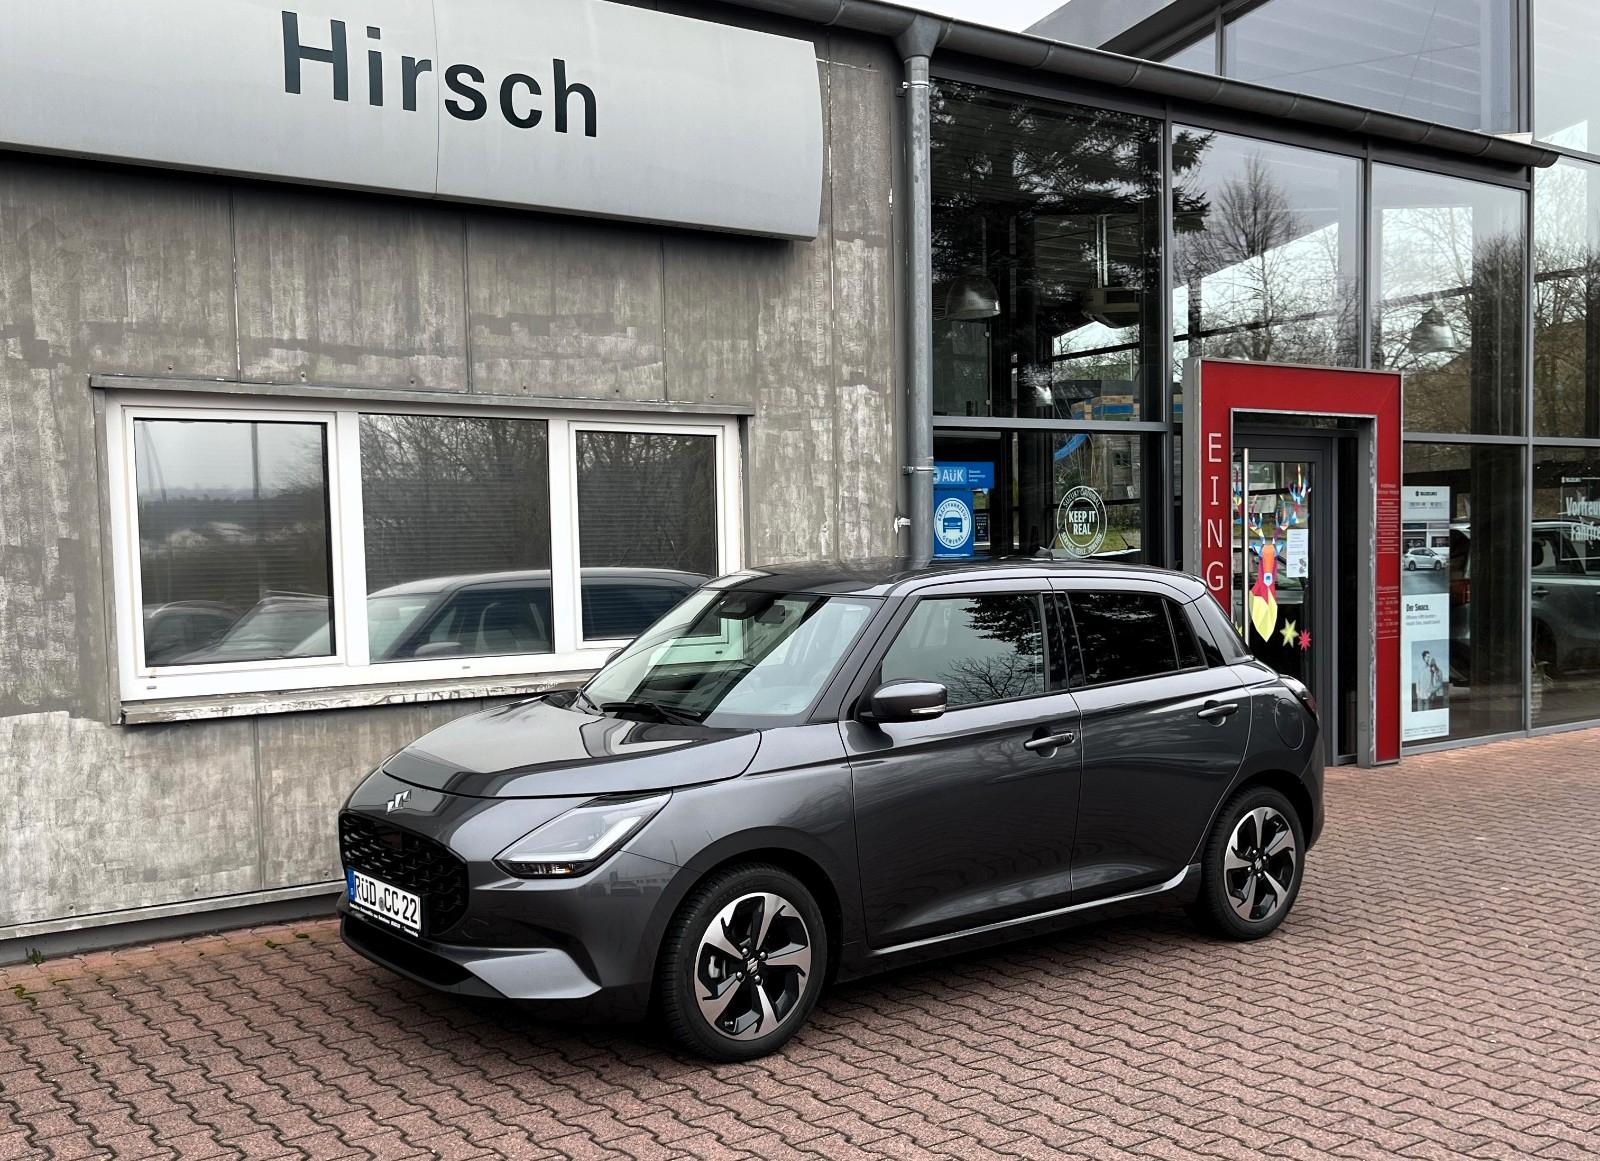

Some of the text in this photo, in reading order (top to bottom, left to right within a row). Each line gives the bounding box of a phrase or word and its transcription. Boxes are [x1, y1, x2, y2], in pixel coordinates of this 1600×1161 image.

[282, 11, 596, 137] Hirsch
[1068, 510, 1096, 523] KEEP IT
[1073, 524, 1092, 535] REAL
[354, 874, 376, 906] RÜD
[384, 887, 399, 916] CC
[402, 895, 418, 924] 22
